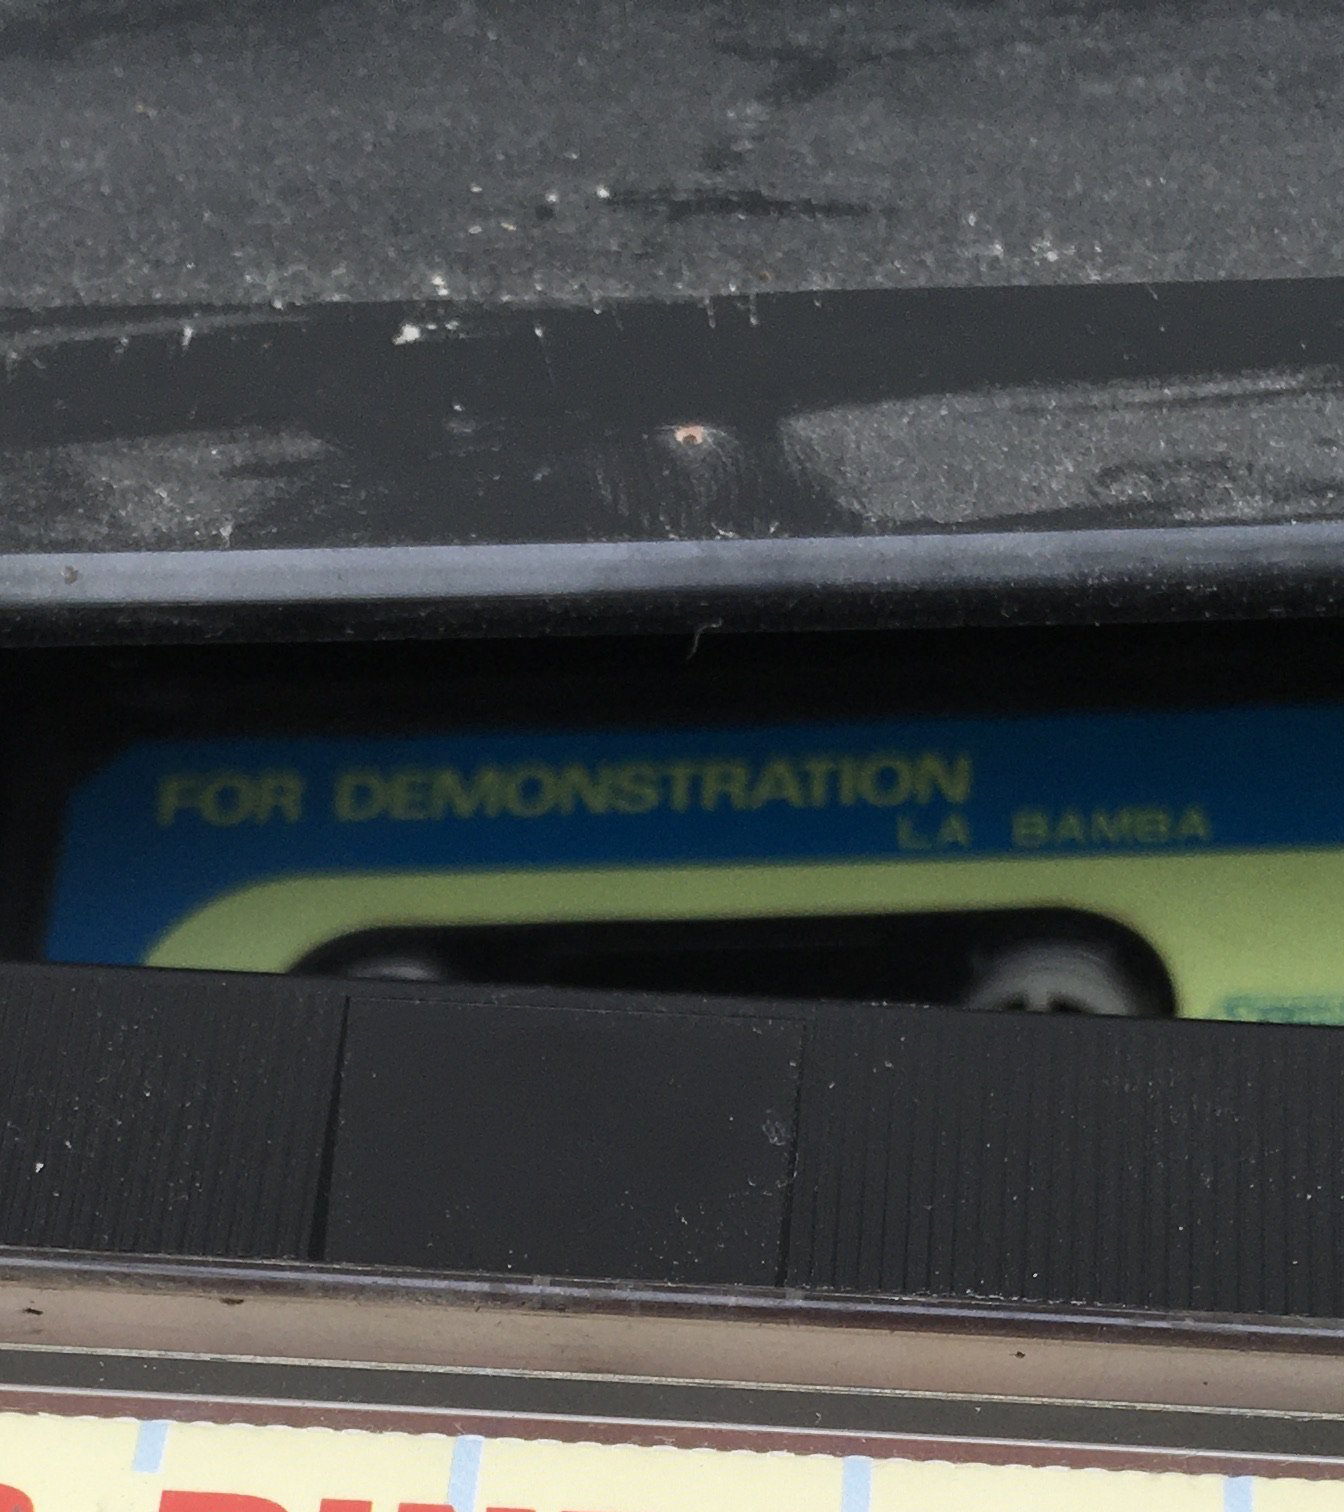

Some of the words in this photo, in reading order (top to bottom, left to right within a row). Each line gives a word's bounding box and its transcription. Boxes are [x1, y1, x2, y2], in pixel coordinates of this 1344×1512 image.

[159, 769, 302, 828] FOR
[334, 752, 972, 822] DEMONSTRATION
[896, 814, 969, 849] LA
[1011, 807, 1210, 848] BAMBA
